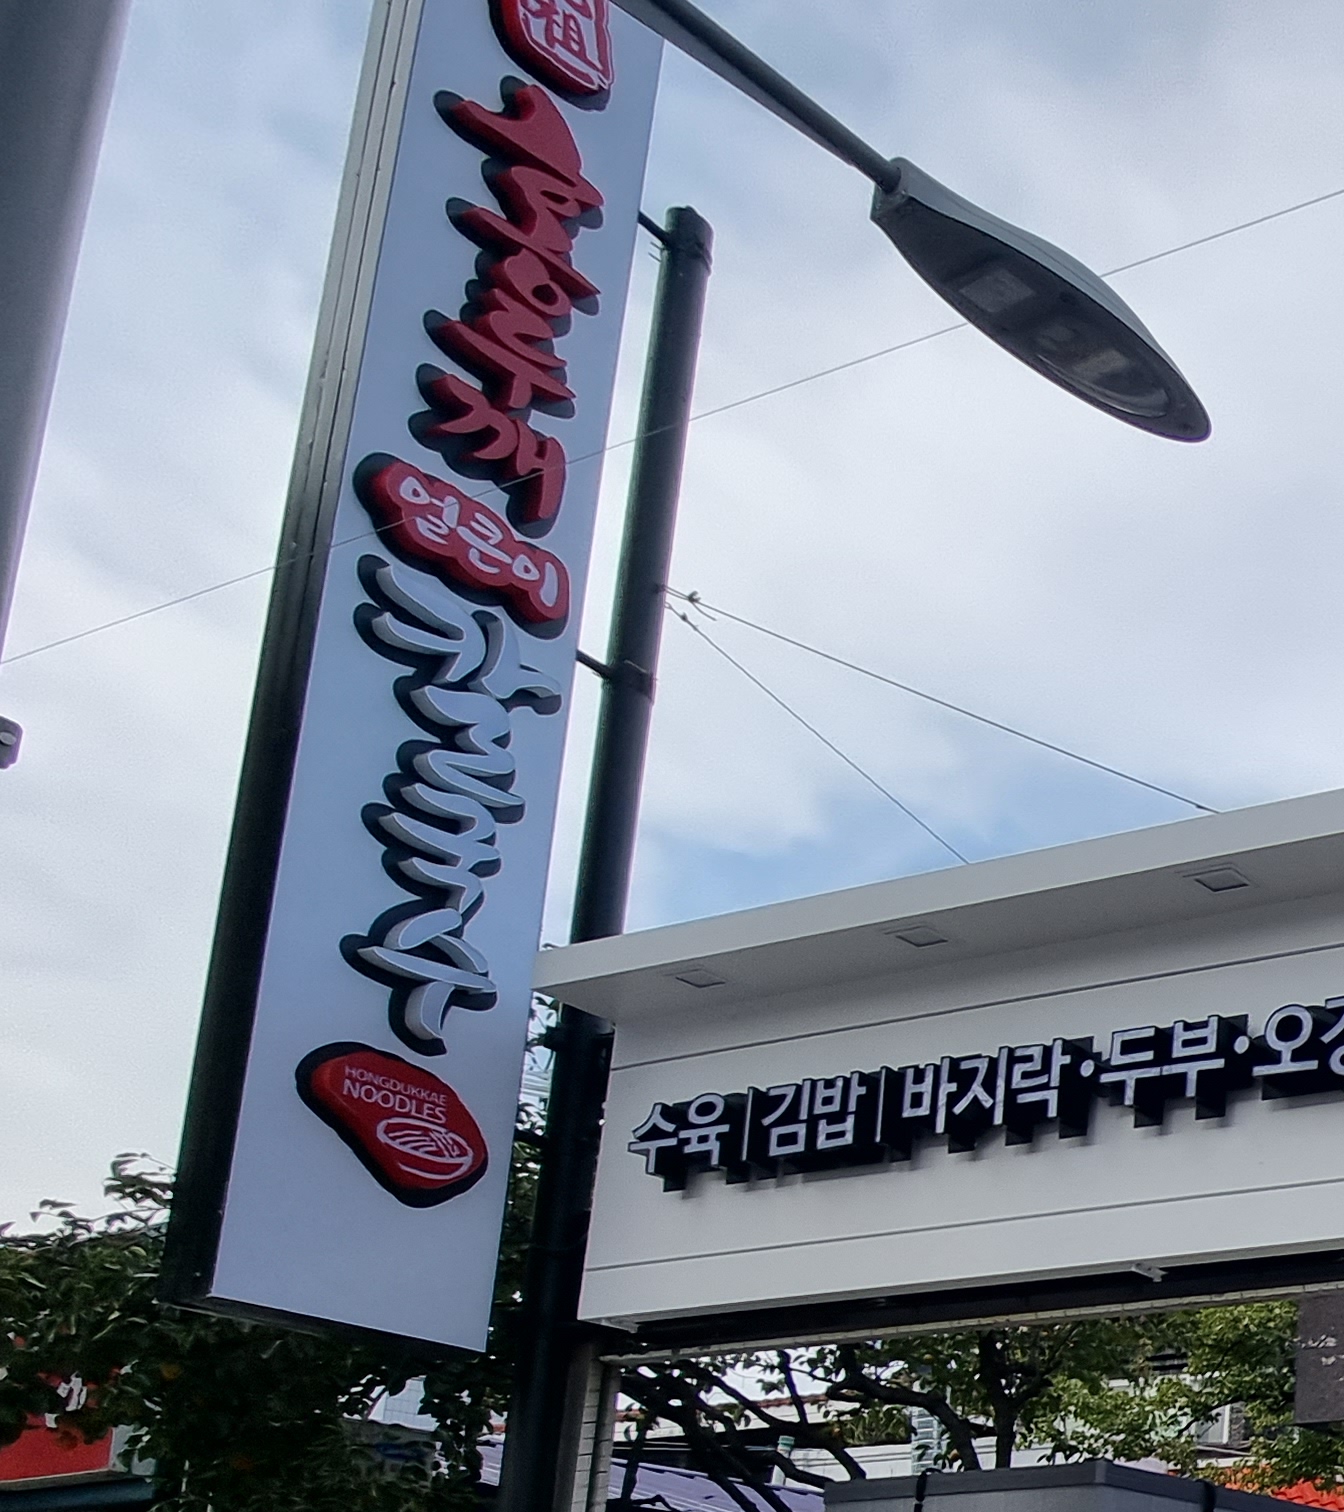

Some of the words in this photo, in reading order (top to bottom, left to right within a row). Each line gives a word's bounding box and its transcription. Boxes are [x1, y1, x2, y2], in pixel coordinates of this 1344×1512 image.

[428, 79, 605, 528] 홍두깨
[400, 475, 559, 608] 얼큰이
[352, 558, 562, 1050] 칼국수
[341, 1078, 450, 1126] NOODLES
[343, 1064, 449, 1106] HONGDUKKAE
